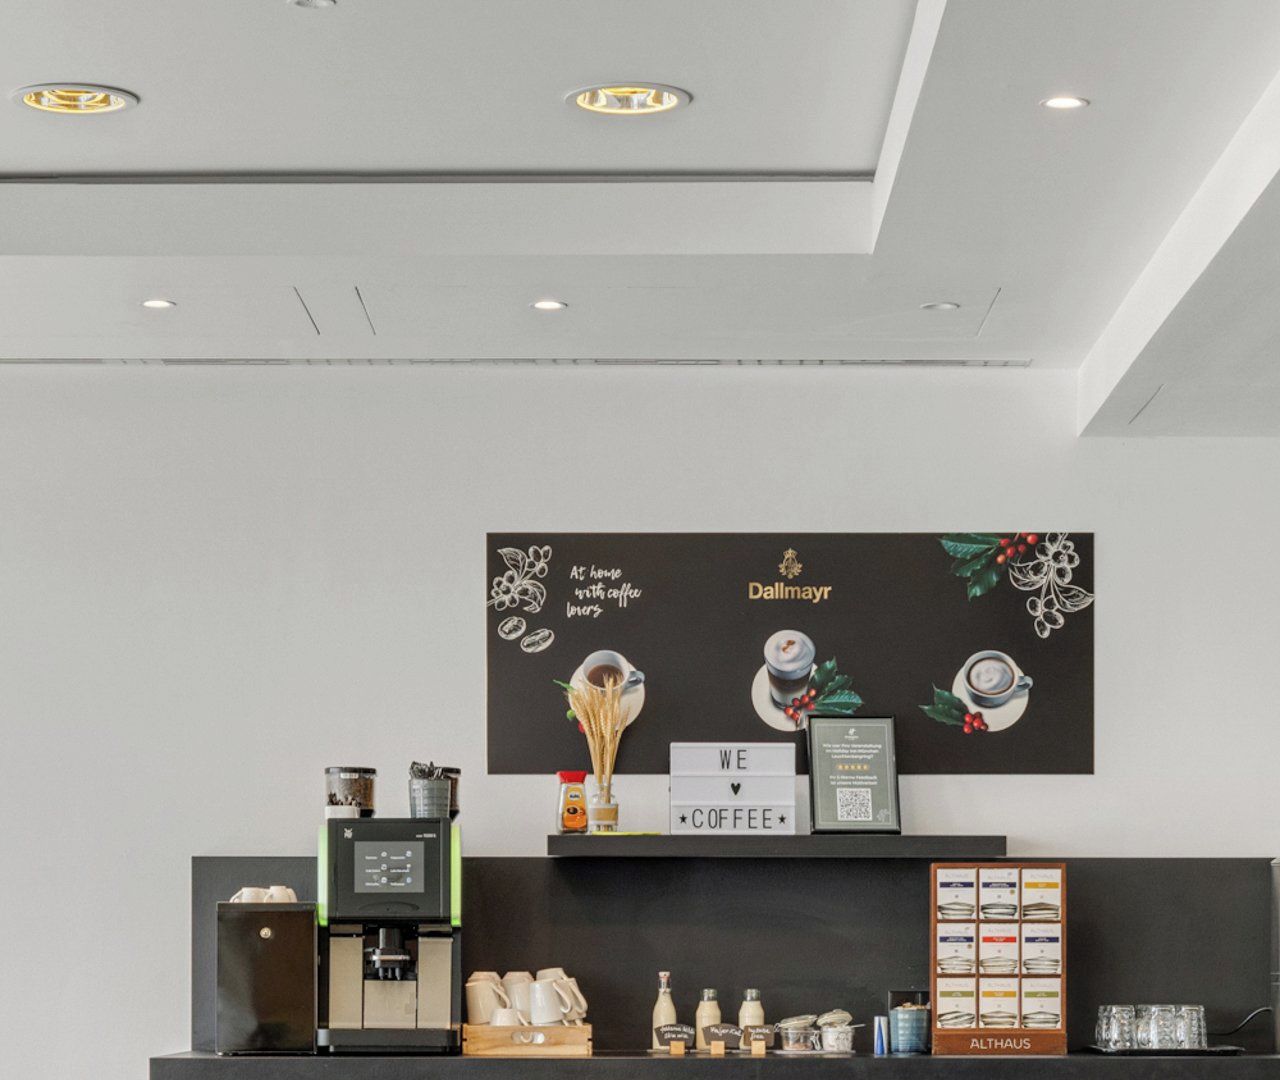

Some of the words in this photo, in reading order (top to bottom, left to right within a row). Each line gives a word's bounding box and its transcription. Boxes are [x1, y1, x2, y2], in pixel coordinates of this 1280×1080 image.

[570, 565, 586, 580] At
[590, 565, 622, 580] home
[575, 582, 606, 600] with
[608, 582, 642, 608] coffee
[748, 582, 832, 603] Dallmayr
[566, 602, 603, 618] lovers
[720, 749, 747, 769] WE
[691, 808, 773, 829] COFFEE
[969, 1038, 1032, 1050] ALTHAUS
